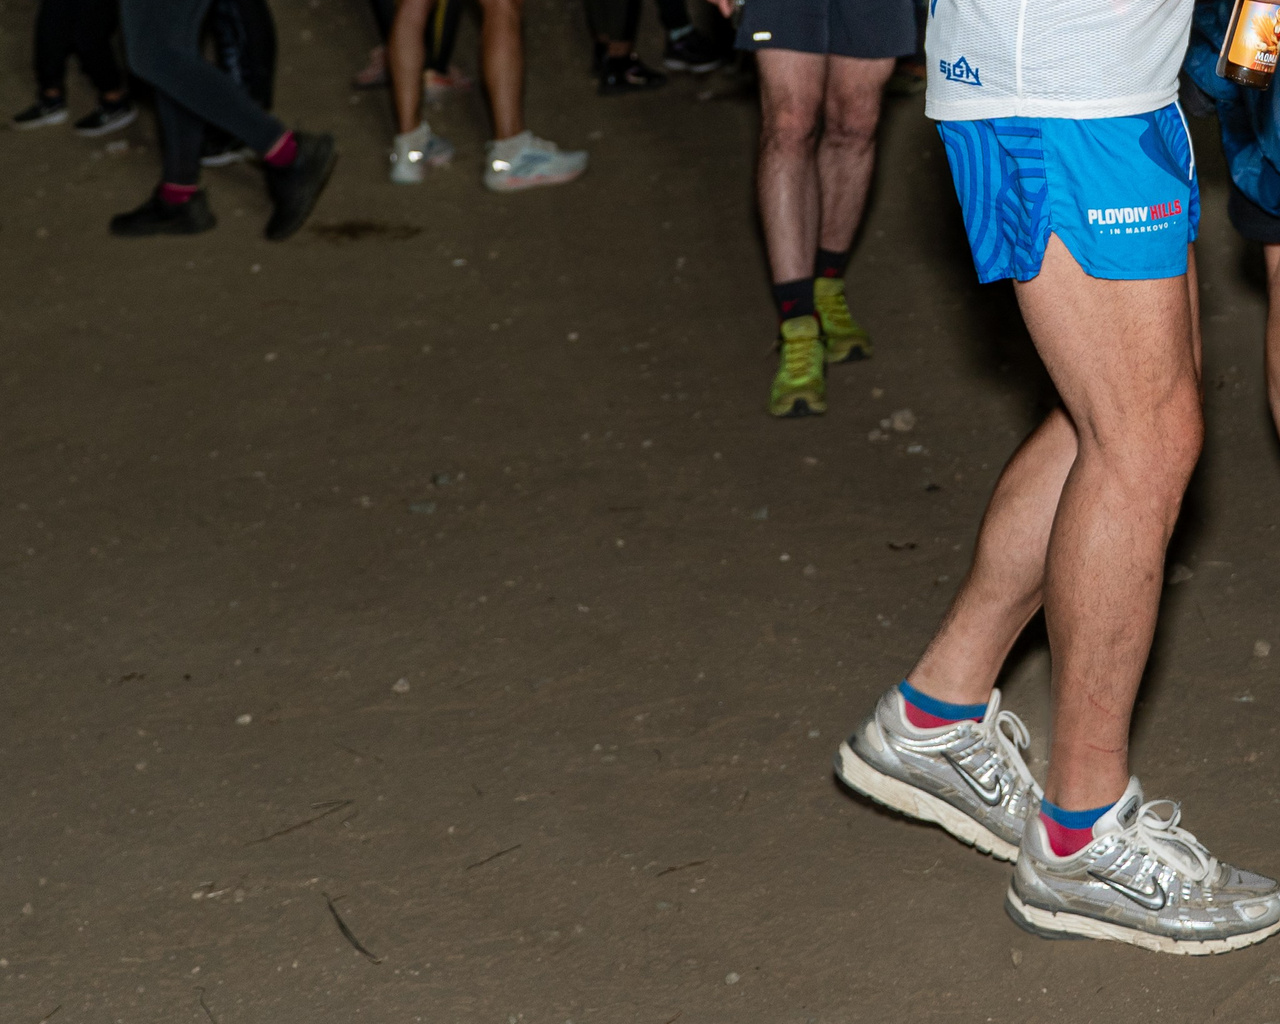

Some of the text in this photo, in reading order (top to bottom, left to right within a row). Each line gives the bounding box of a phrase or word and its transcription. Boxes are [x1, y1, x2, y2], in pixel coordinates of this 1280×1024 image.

[1087, 198, 1183, 225] PLOVDIV HILLS
[1125, 222, 1169, 234] MARKOVO
